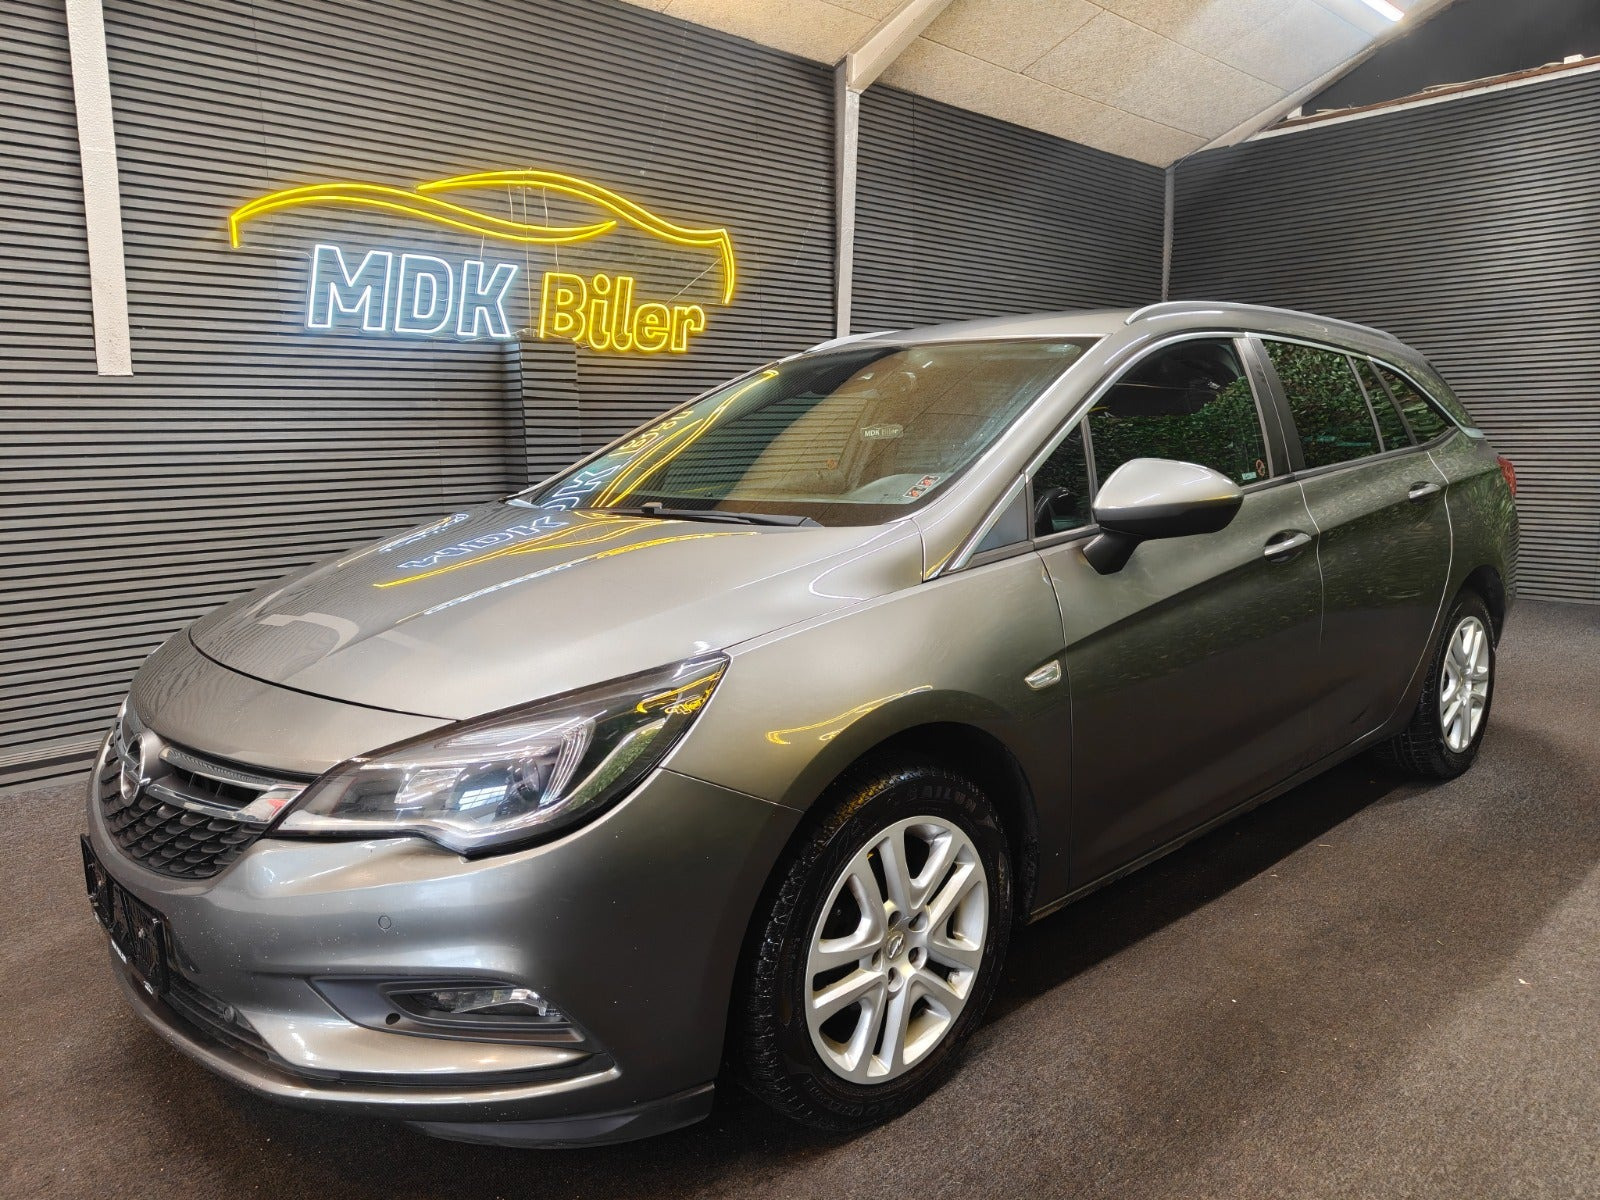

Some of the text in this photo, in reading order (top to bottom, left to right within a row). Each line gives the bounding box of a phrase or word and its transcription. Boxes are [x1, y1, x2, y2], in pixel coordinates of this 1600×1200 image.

[306, 244, 706, 352] MDK Biler
[864, 430, 880, 438] MDK
